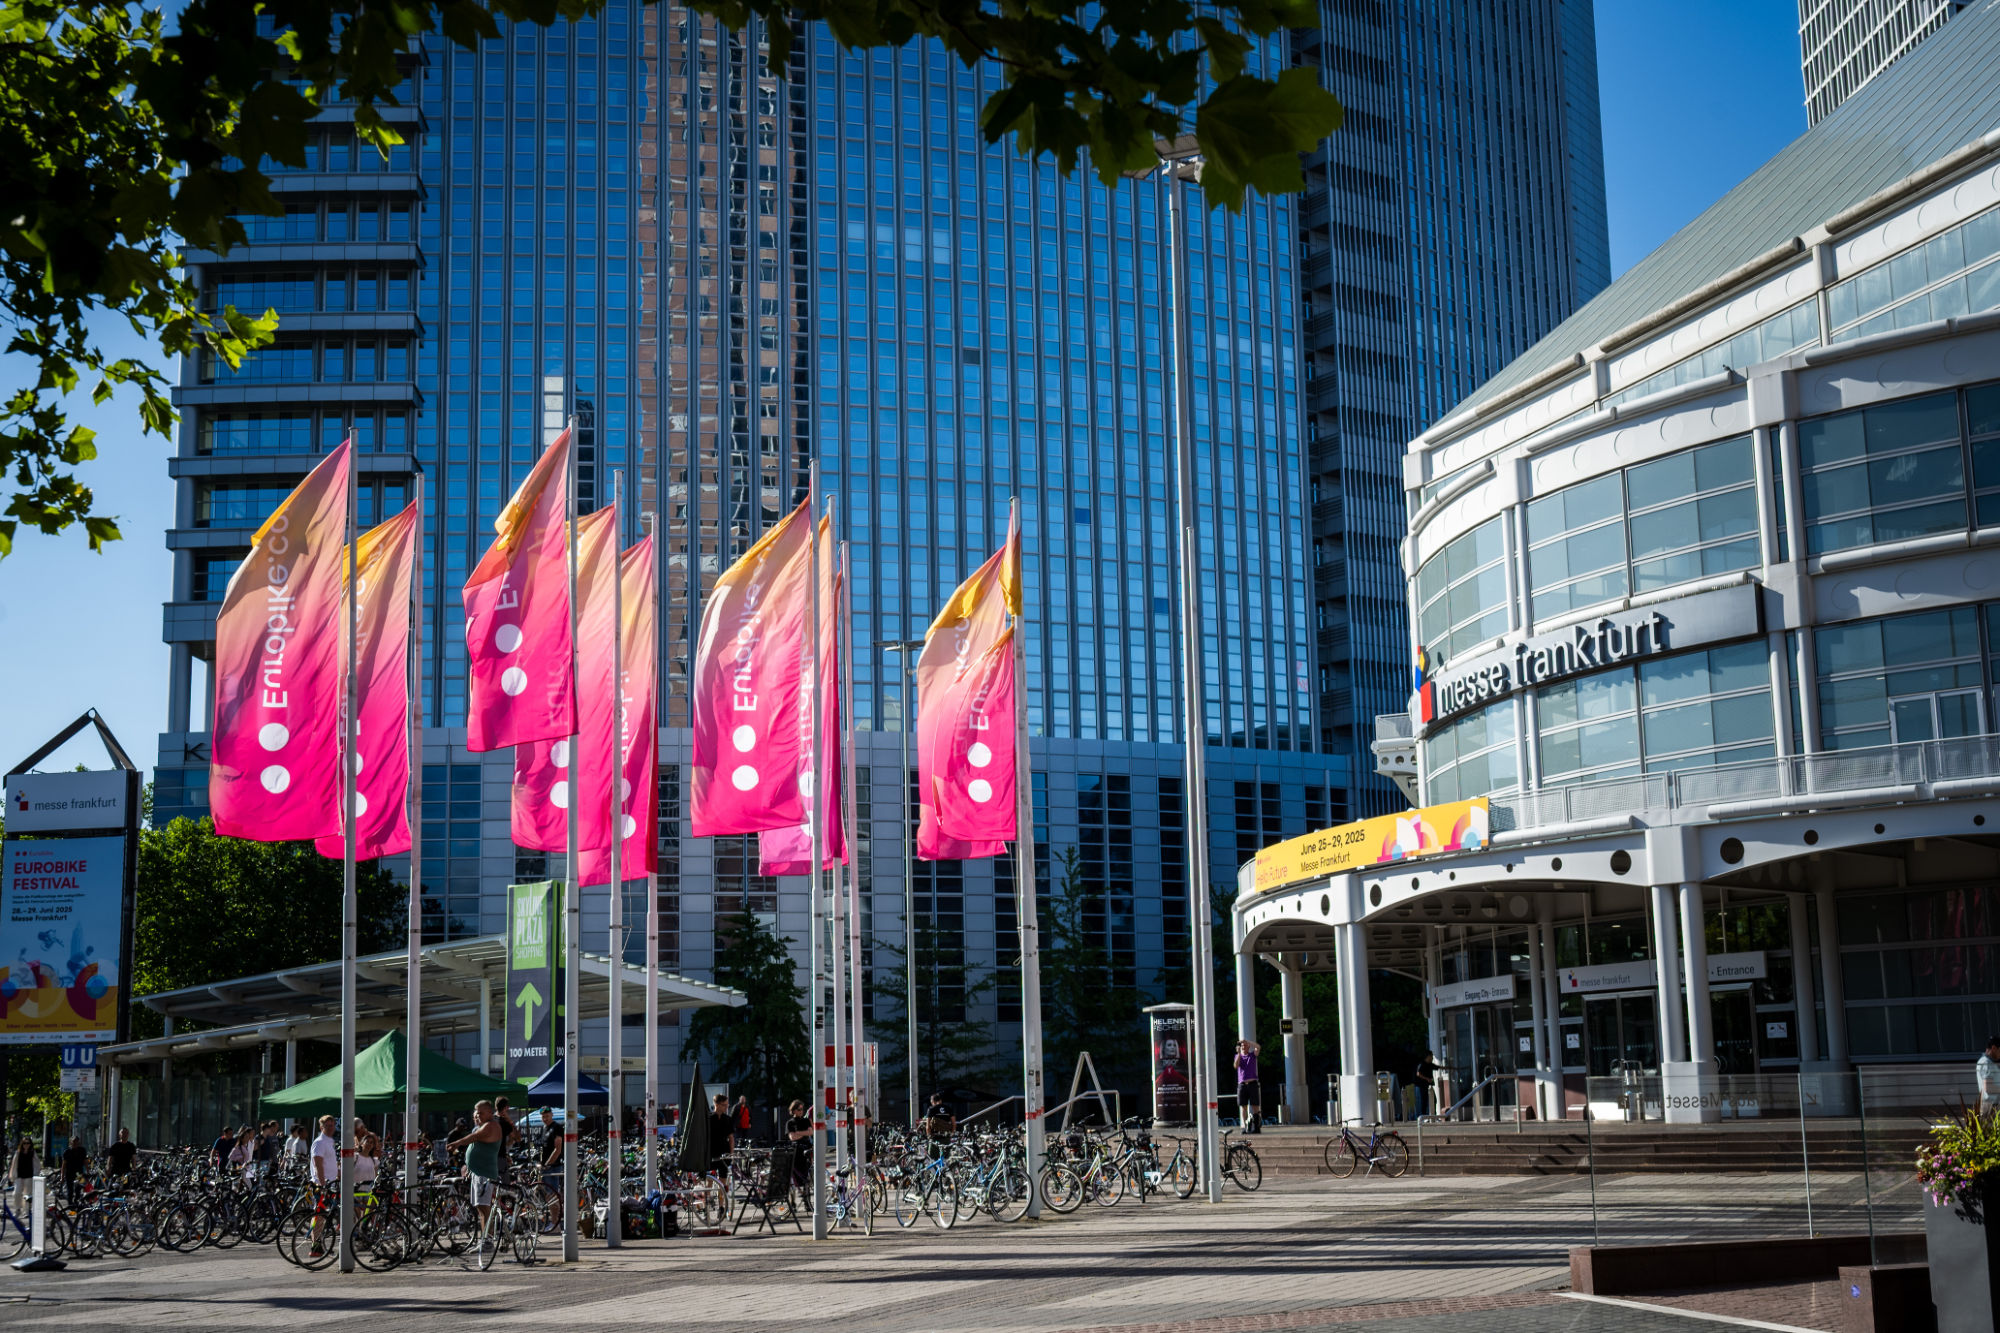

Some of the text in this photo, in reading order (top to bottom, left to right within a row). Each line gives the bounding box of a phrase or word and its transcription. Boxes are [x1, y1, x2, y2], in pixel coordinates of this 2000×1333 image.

[1439, 612, 1663, 709] messe frankfurt
[34, 796, 117, 811] messe frankfurt
[1300, 843, 1317, 856] June
[1345, 829, 1366, 845] 2025
[14, 860, 87, 874] EUROBIKE
[1300, 851, 1350, 873] Messe Frankfurt
[13, 877, 79, 891] FESTIVAL
[516, 888, 543, 917] SKYLINE
[39, 906, 54, 914] Juni
[11, 913, 68, 922] Messe Frankfurt
[516, 917, 543, 945] PLAZA
[516, 945, 543, 959] SHOPPING
[1716, 964, 1755, 977] Entrance
[1580, 974, 1631, 987] messe frankfurt
[64, 1047, 94, 1065] U U
[509, 1046, 547, 1057] 100 METER
